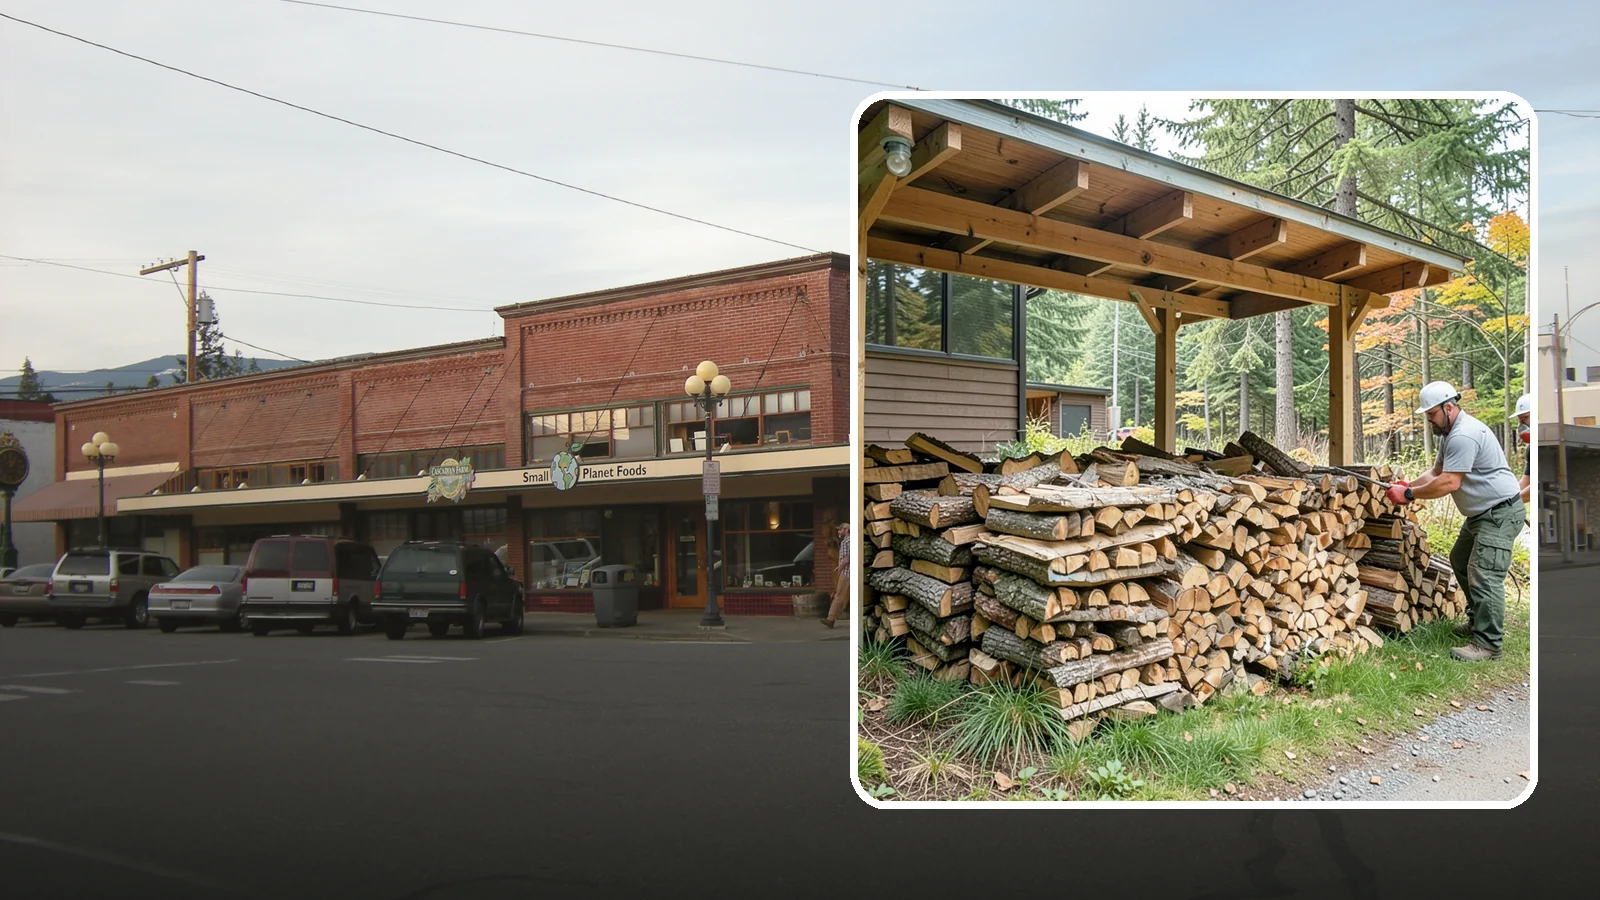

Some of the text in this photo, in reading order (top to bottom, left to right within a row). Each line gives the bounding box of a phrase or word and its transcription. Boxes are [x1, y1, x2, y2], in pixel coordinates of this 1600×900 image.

[523, 464, 647, 482] Small Planet Foods
